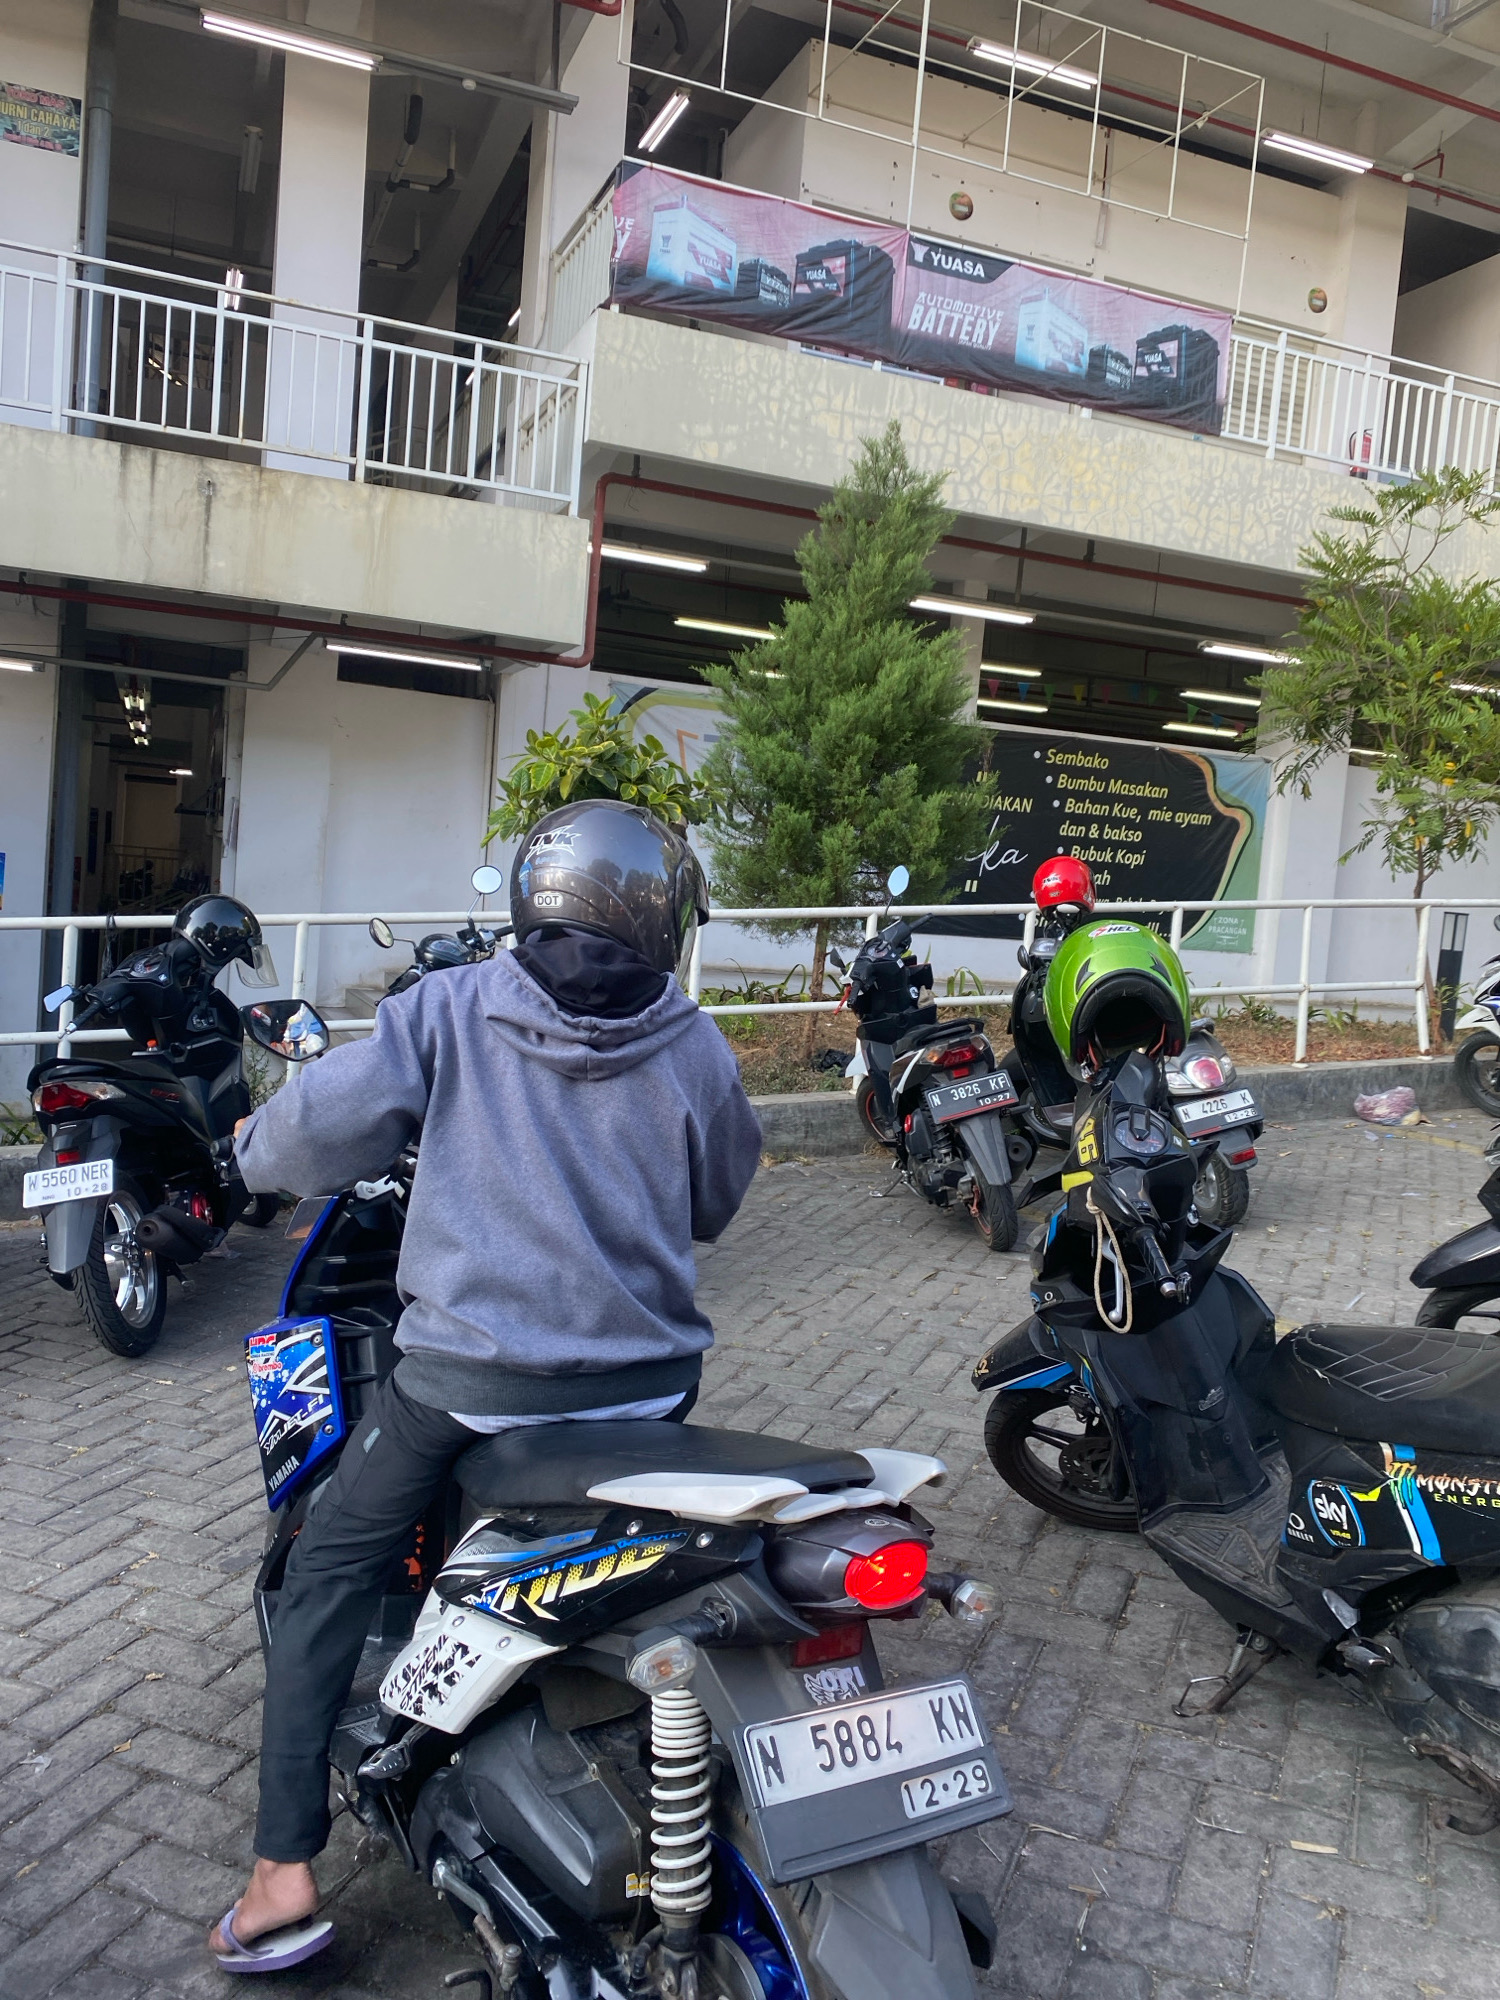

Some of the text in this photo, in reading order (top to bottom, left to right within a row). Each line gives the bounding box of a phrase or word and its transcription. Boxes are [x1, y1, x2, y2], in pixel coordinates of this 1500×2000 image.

[0, 101, 76, 131] URNI CAHAYA
[24, 122, 41, 136] dan
[44, 126, 50, 138] 2
[699, 253, 723, 272] YUASA
[806, 269, 827, 281] YUASA
[931, 251, 985, 278] YUASA
[916, 291, 1005, 321] AUTOMOTIVE
[907, 303, 1001, 346] BATTERY
[1144, 352, 1162, 363] YUASA
[1046, 749, 1109, 770] Sembako
[1057, 774, 1169, 799] Bumbu Masakan
[1064, 799, 1212, 828] Bahan Kue, mie ayam
[1059, 821, 1143, 842] dan & bakso
[1070, 846, 1147, 868] Bubuk Kopi
[537, 895, 560, 906] DOT
[1208, 925, 1247, 936] PRACANGAN
[1218, 916, 1239, 925] ZONA
[931, 1076, 1006, 1107] N 3826 KF
[1182, 1092, 1250, 1120] N 4226 K
[28, 1163, 108, 1191] W 5560 NER
[258, 1361, 283, 1373] brembo
[268, 1455, 300, 1492] YAMAHA
[1314, 1493, 1348, 1530] sky
[756, 1692, 975, 1788] N 5884 KN
